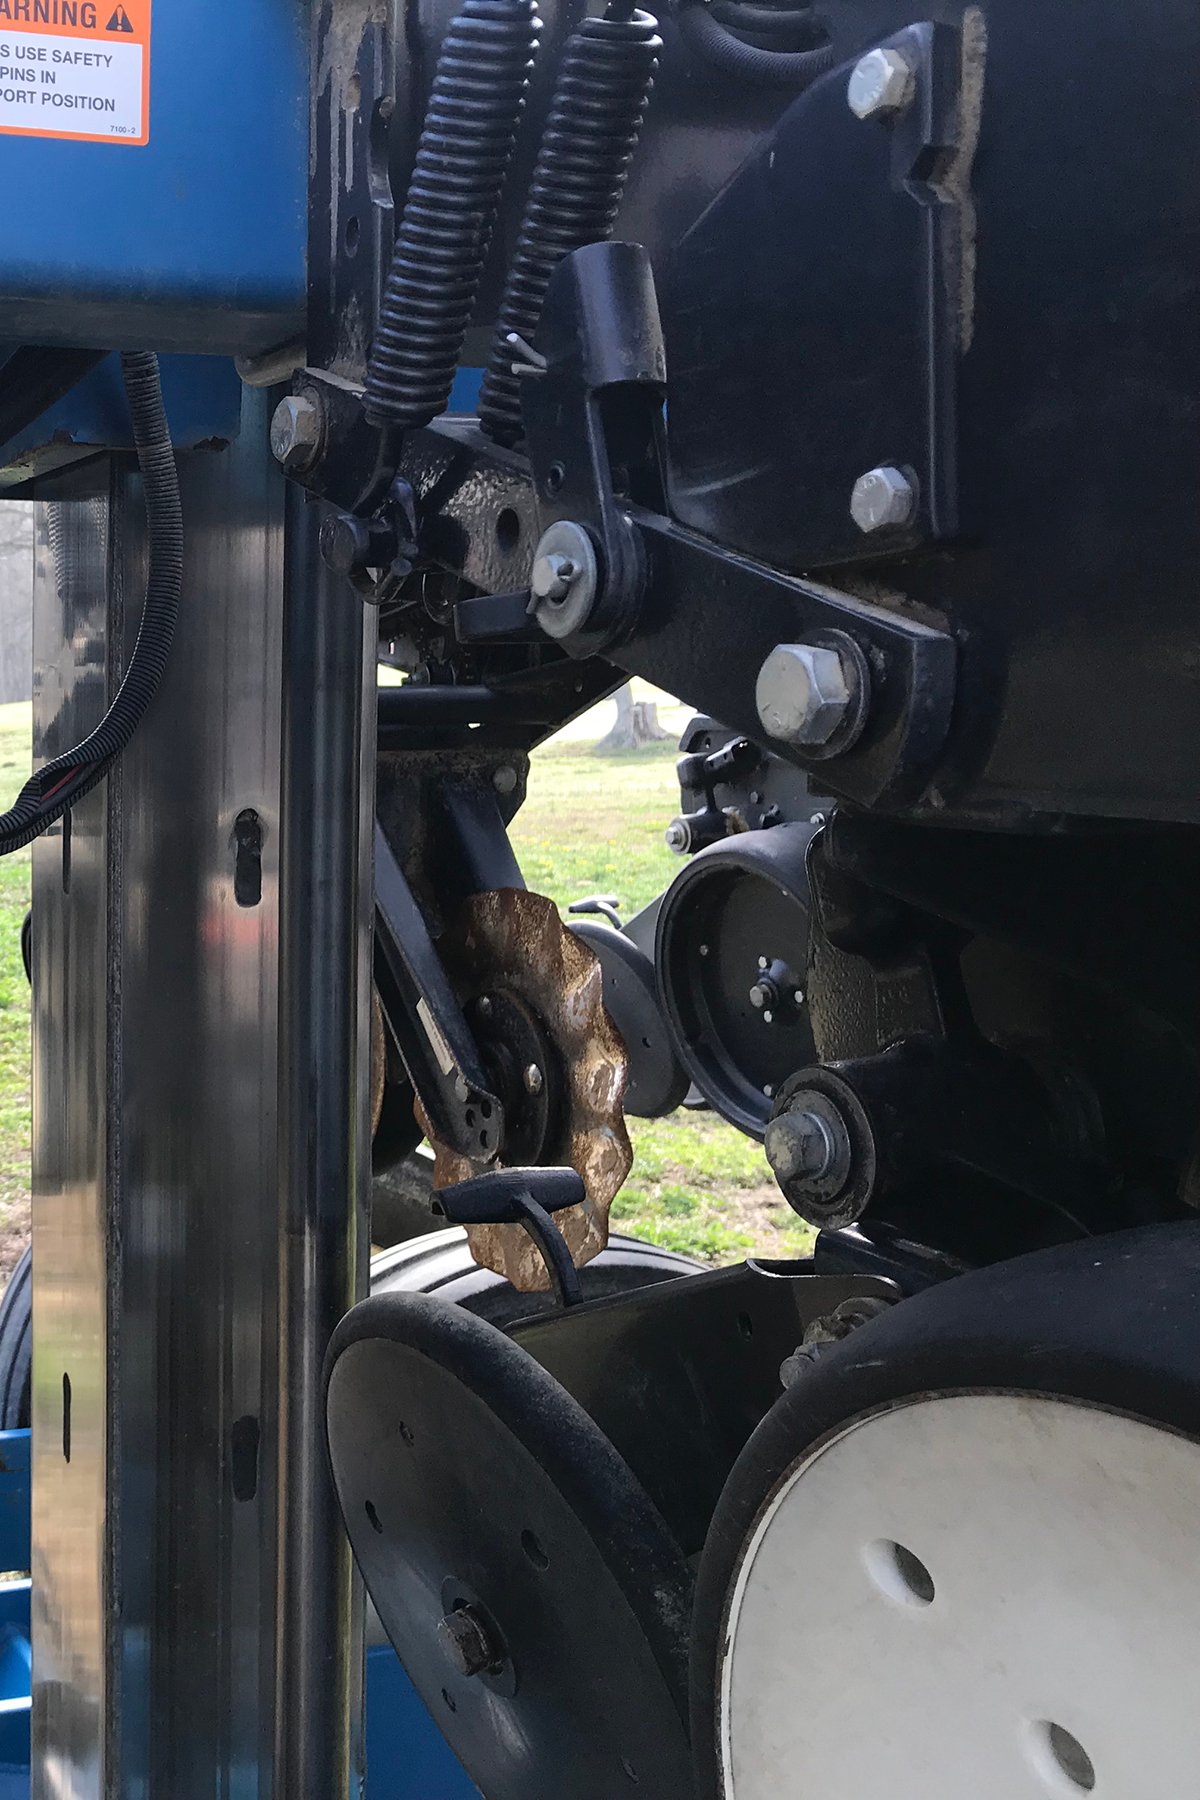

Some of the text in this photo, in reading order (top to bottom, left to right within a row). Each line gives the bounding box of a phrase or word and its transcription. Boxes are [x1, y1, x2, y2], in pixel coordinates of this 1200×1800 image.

[15, 46, 47, 62] USE
[52, 49, 113, 68] SAFETY
[0, 66, 56, 84] PINS IN
[41, 93, 115, 112] POSITION
